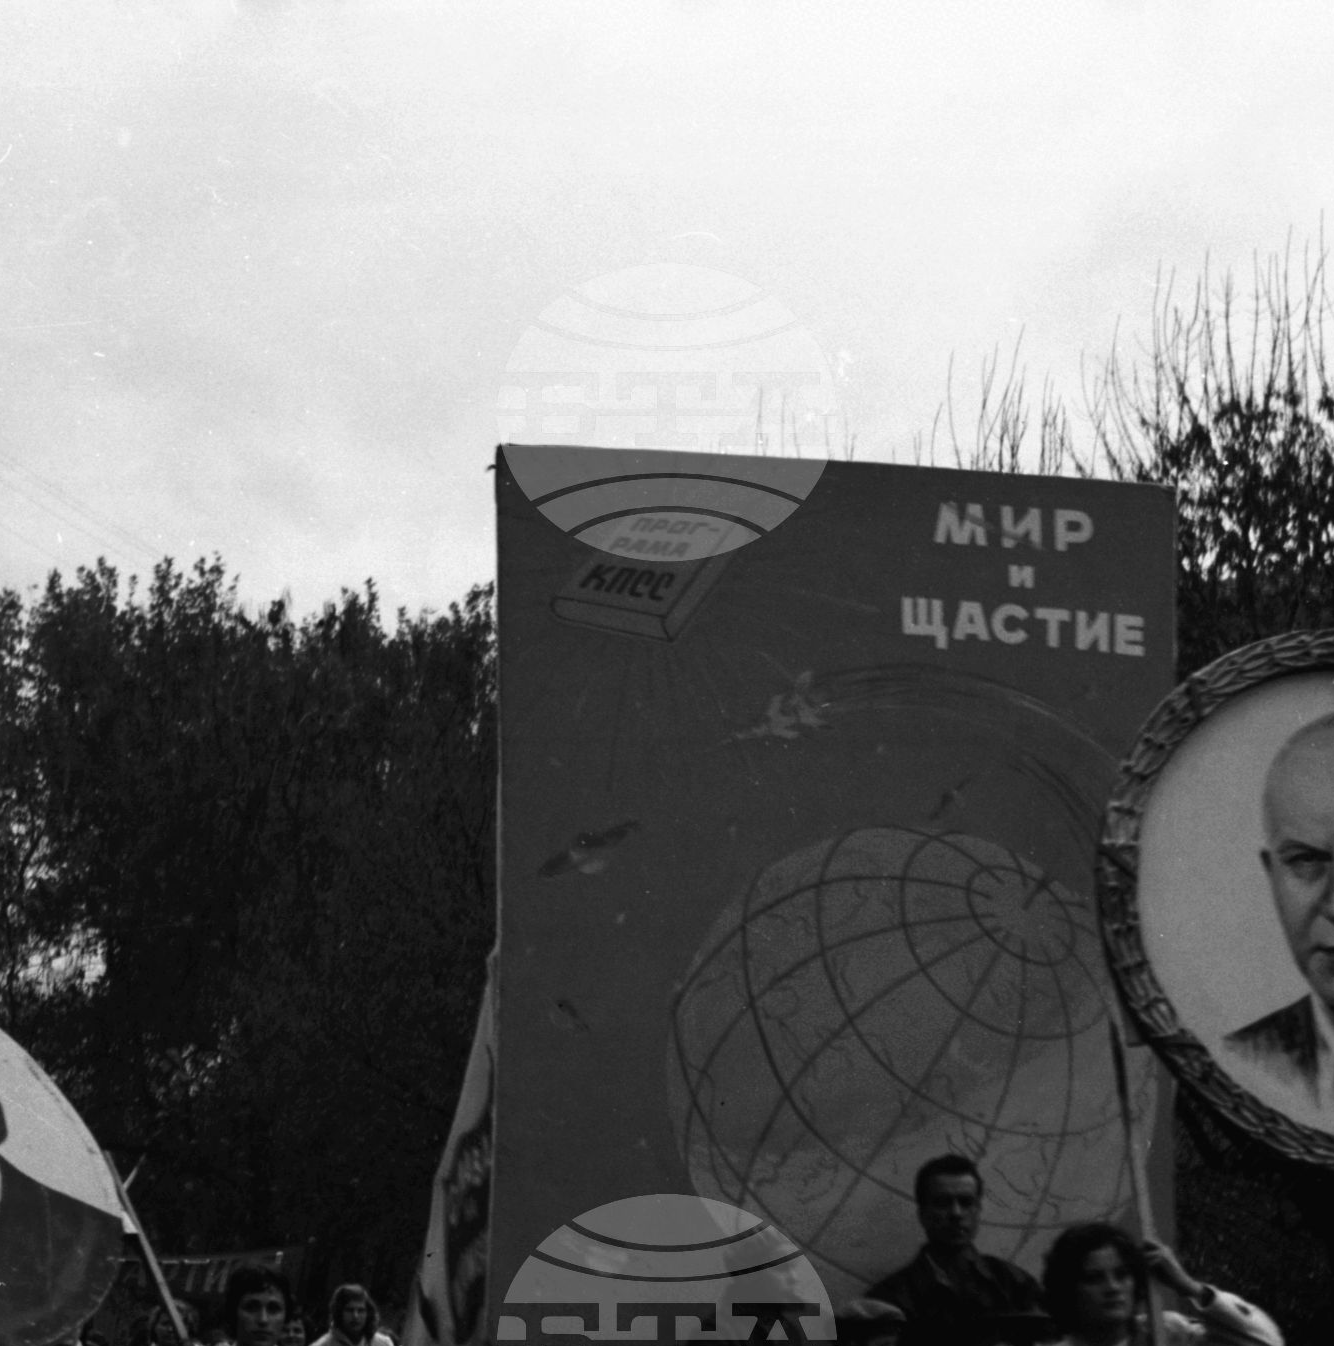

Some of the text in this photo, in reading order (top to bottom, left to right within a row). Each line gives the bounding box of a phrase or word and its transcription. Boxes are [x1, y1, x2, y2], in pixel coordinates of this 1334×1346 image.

[933, 501, 1095, 552] МИР
[579, 564, 676, 601] КПСС
[901, 596, 1146, 657] ЩАСТИЕ
